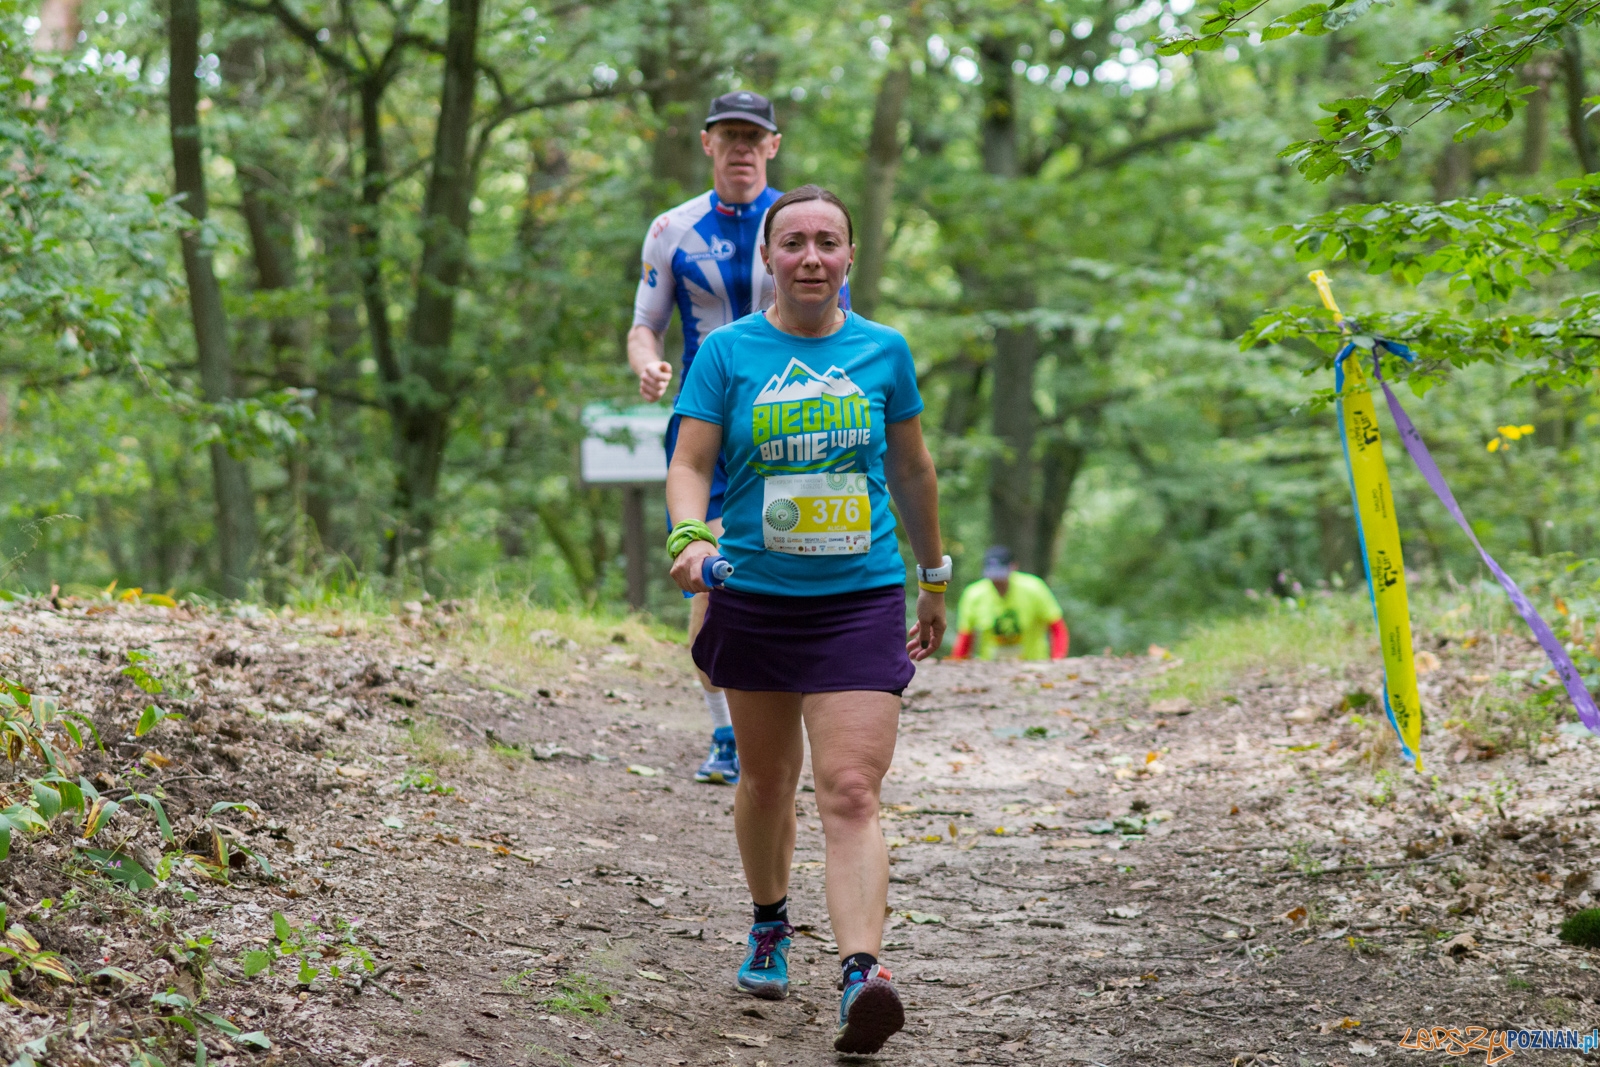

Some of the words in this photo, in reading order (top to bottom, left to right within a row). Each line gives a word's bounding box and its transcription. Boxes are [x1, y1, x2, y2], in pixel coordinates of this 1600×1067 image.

[752, 392, 871, 446] BIEGAM
[760, 440, 784, 461] BO
[787, 432, 828, 461] NIE
[812, 498, 860, 524] 376
